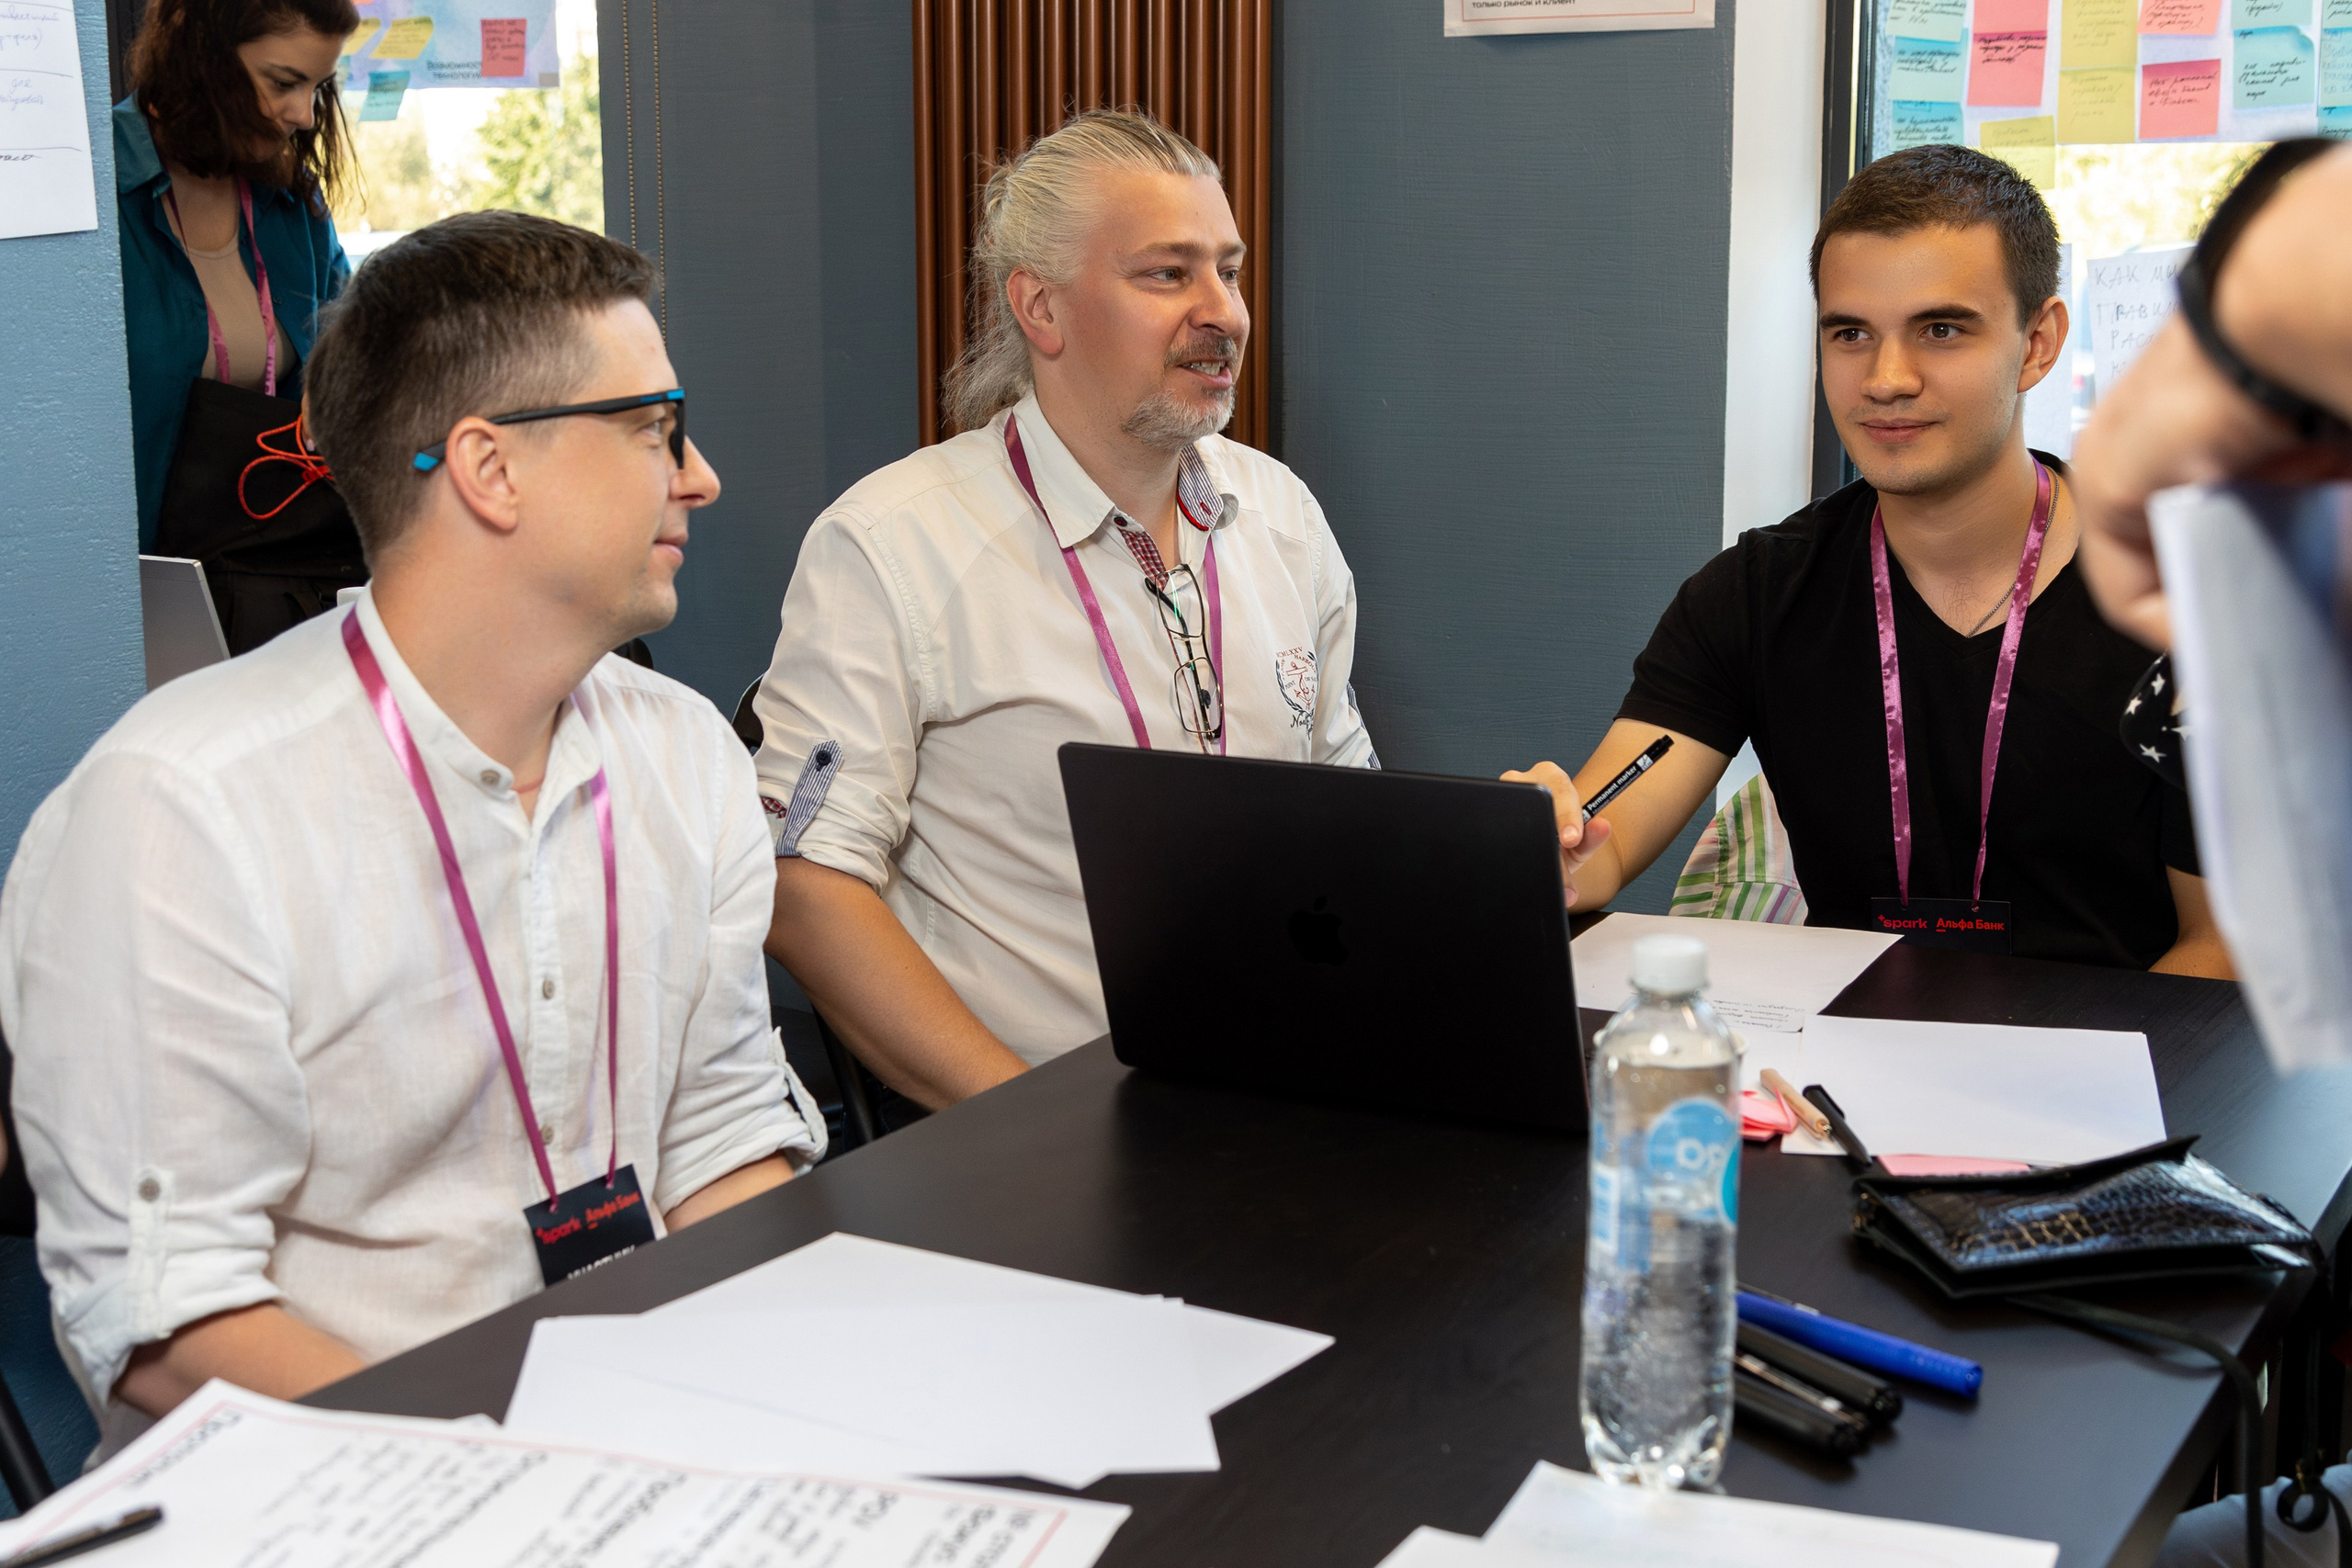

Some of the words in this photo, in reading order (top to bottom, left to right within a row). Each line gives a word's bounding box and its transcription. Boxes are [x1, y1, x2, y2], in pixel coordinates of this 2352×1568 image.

[2094, 265, 2140, 289] КАК
[1587, 783, 1618, 811] Permanent
[1617, 765, 1638, 785] marker
[1883, 919, 1928, 930] spark
[1936, 918, 1973, 931] Альфа
[1975, 919, 2005, 931] Банк
